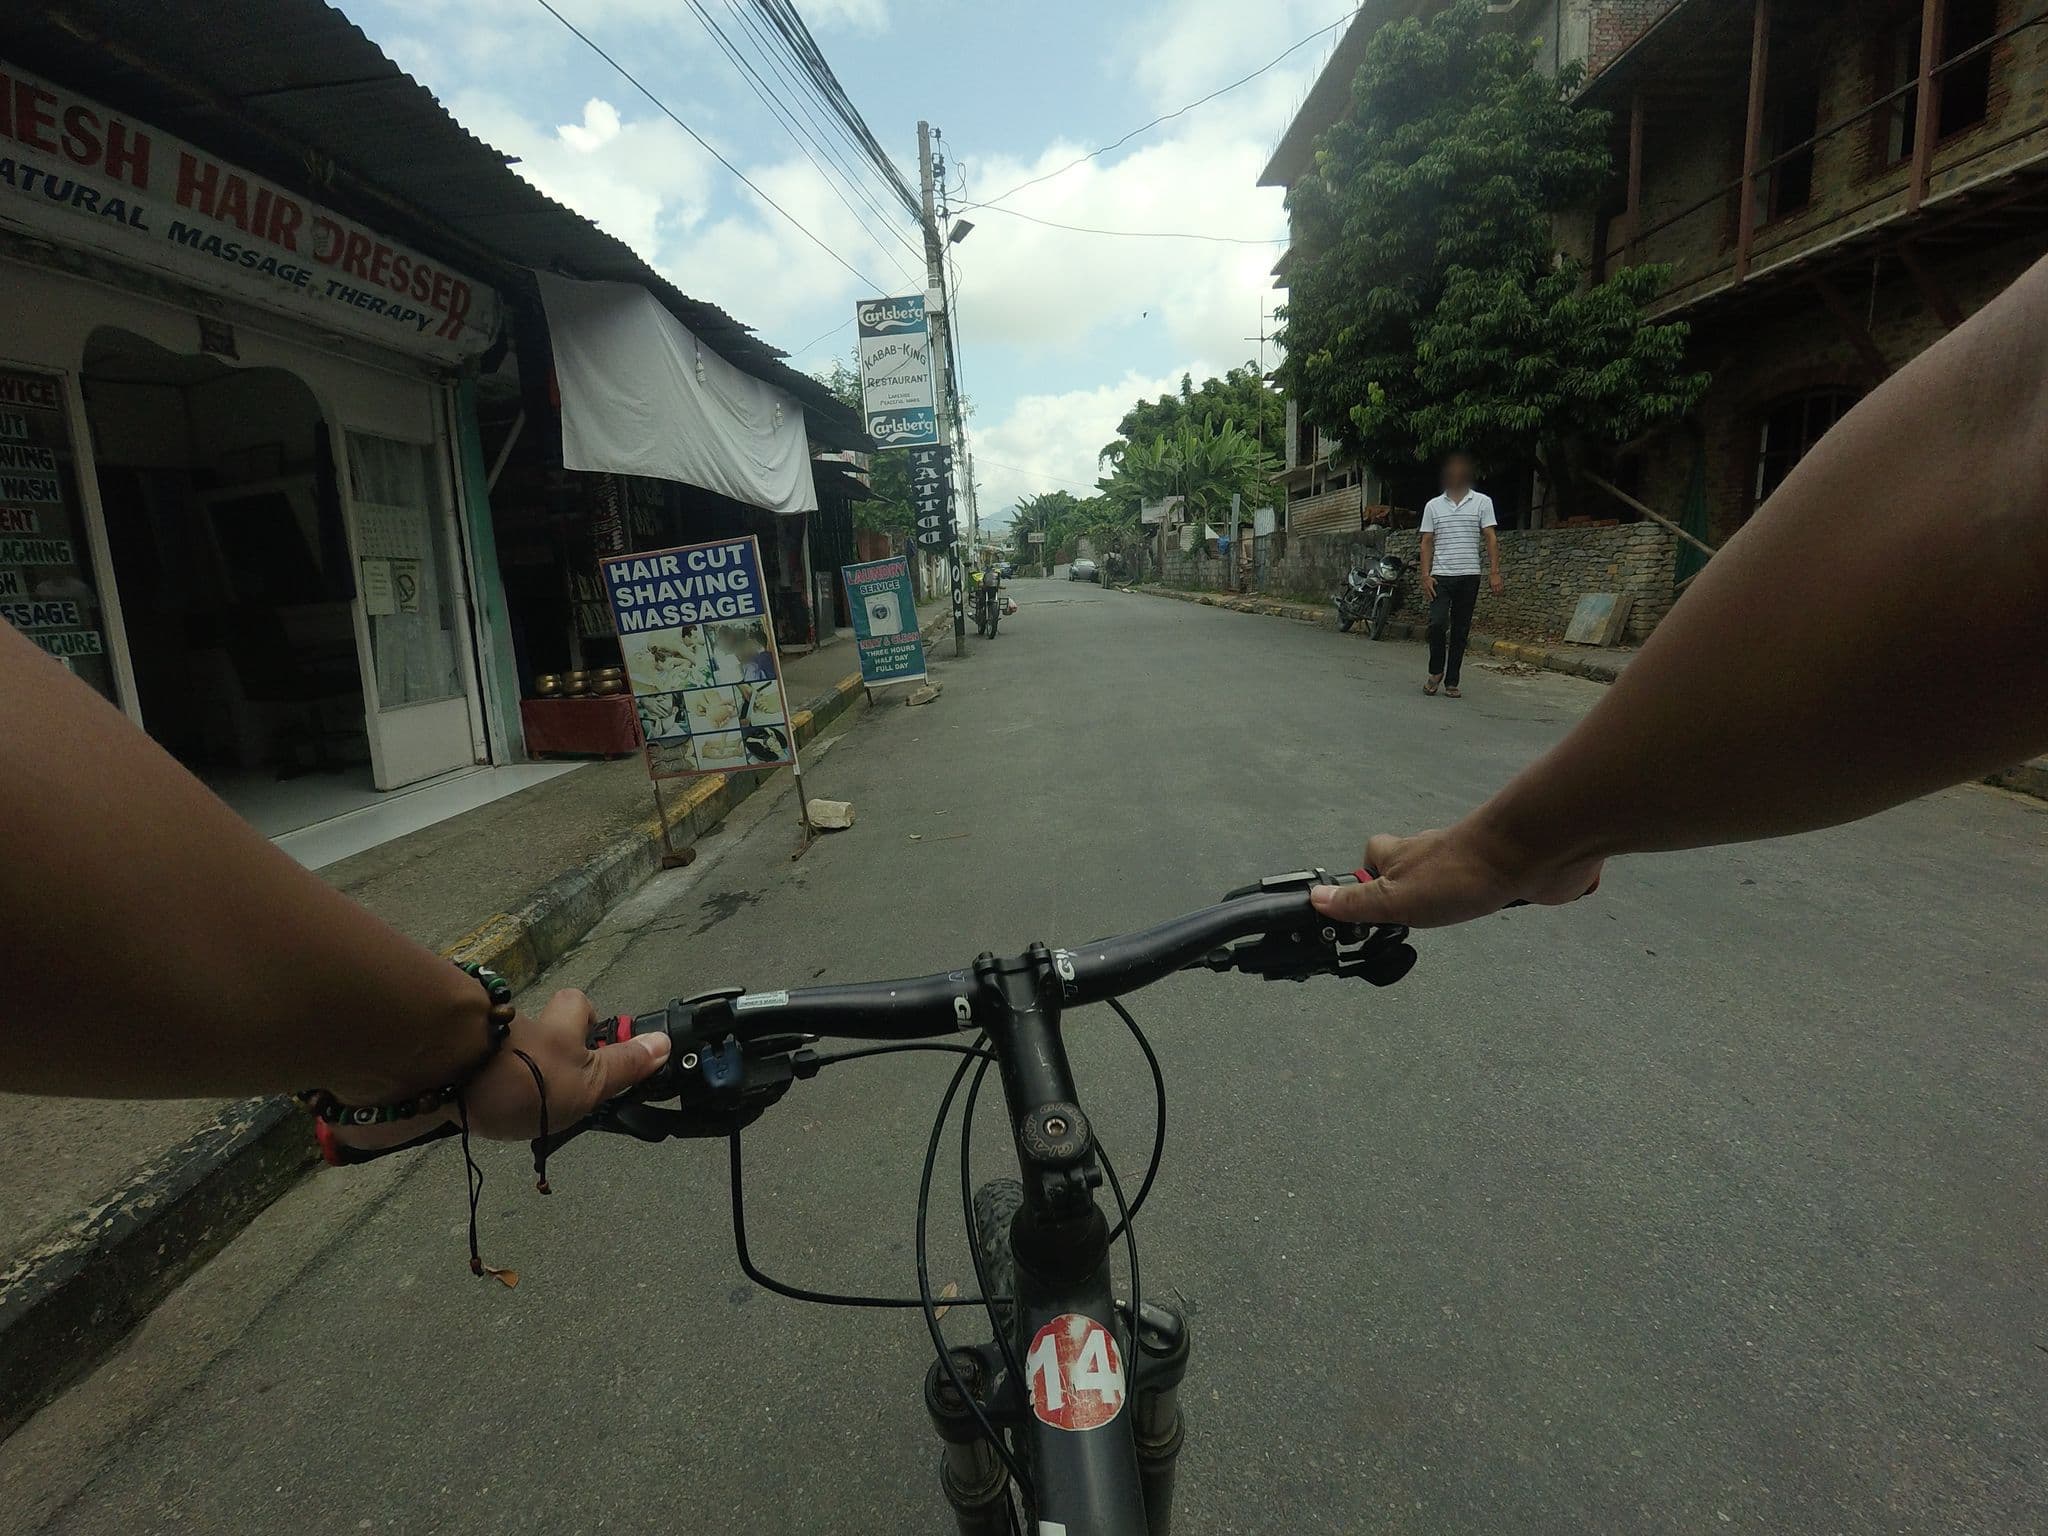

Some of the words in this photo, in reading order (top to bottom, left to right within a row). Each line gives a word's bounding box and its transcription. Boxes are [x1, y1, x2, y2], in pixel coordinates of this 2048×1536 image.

[0, 157, 149, 231] ATURAL
[325, 278, 434, 332] THERAPY
[176, 151, 303, 252] HAIR
[312, 215, 472, 341] DRESSER
[859, 303, 924, 330] Carlsberg
[867, 373, 928, 388] RESTAURANT
[870, 415, 934, 442] Carlsberg
[0, 447, 54, 471] VING
[912, 450, 941, 545] TATTOO
[944, 471, 962, 605] TATTOO
[610, 556, 681, 584] HAIR
[688, 545, 745, 571] CUT
[846, 561, 906, 585] LAUNDRY
[615, 569, 750, 608] SHAVING
[860, 580, 900, 594] SERVICE
[620, 593, 756, 632] MASSAGE
[866, 649, 889, 657] THREE
[890, 644, 916, 654] HOURS
[874, 656, 893, 665] HALF
[875, 664, 894, 673] FULL
[895, 663, 909, 671] DAY
[1027, 1328, 1123, 1412] 14
